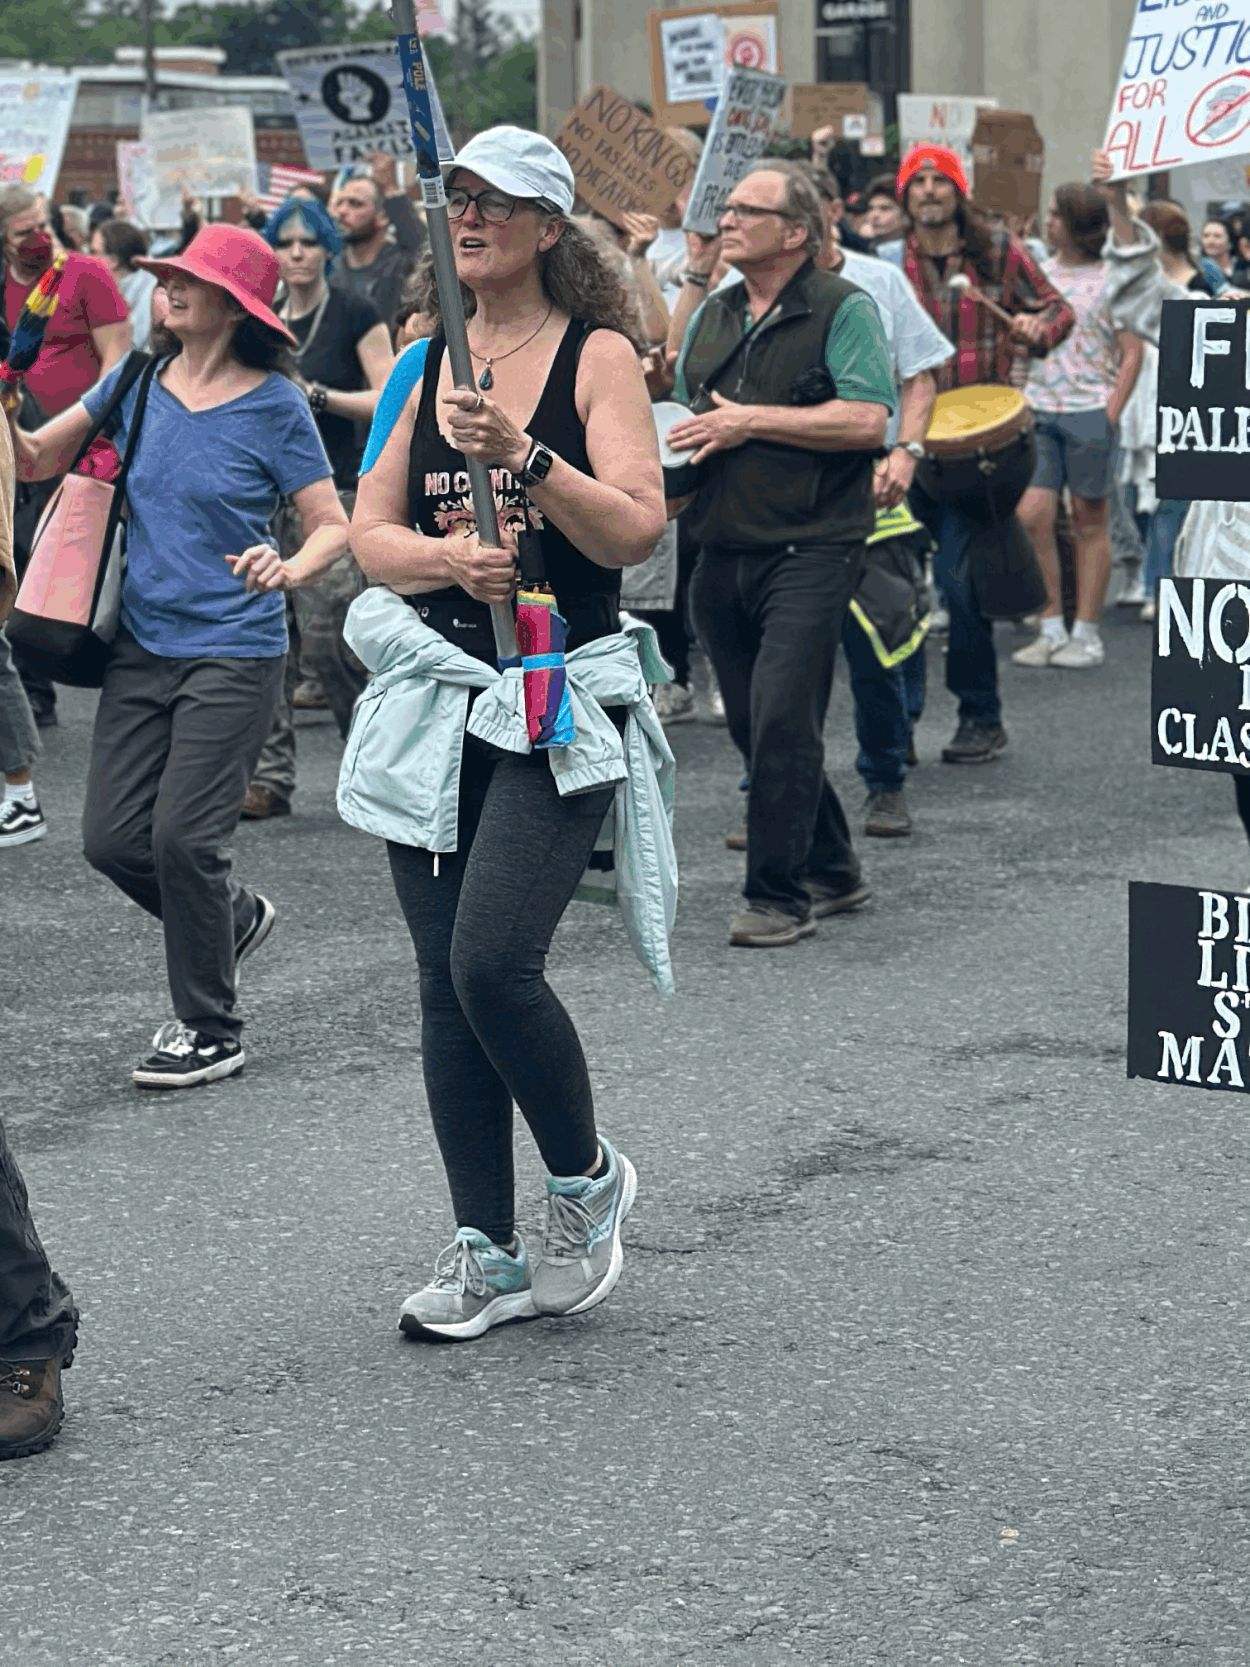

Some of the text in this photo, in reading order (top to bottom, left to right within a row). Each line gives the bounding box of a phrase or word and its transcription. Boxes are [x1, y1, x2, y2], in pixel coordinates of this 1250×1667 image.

[1195, 2, 1229, 22] AND
[1118, 78, 1167, 113] FOR
[334, 137, 414, 164] FASCIS
[554, 135, 581, 166] NO
[566, 116, 657, 192] NO FASCISTS
[584, 88, 633, 134] NO
[622, 117, 697, 188] KINGS
[1106, 115, 1183, 171] ALL
[1190, 307, 1250, 390] F
[425, 471, 450, 496] NO
[1158, 578, 1250, 665] NO
[1197, 939, 1250, 992] LI
[1212, 991, 1250, 1039] S
[1157, 1030, 1250, 1088] MA
